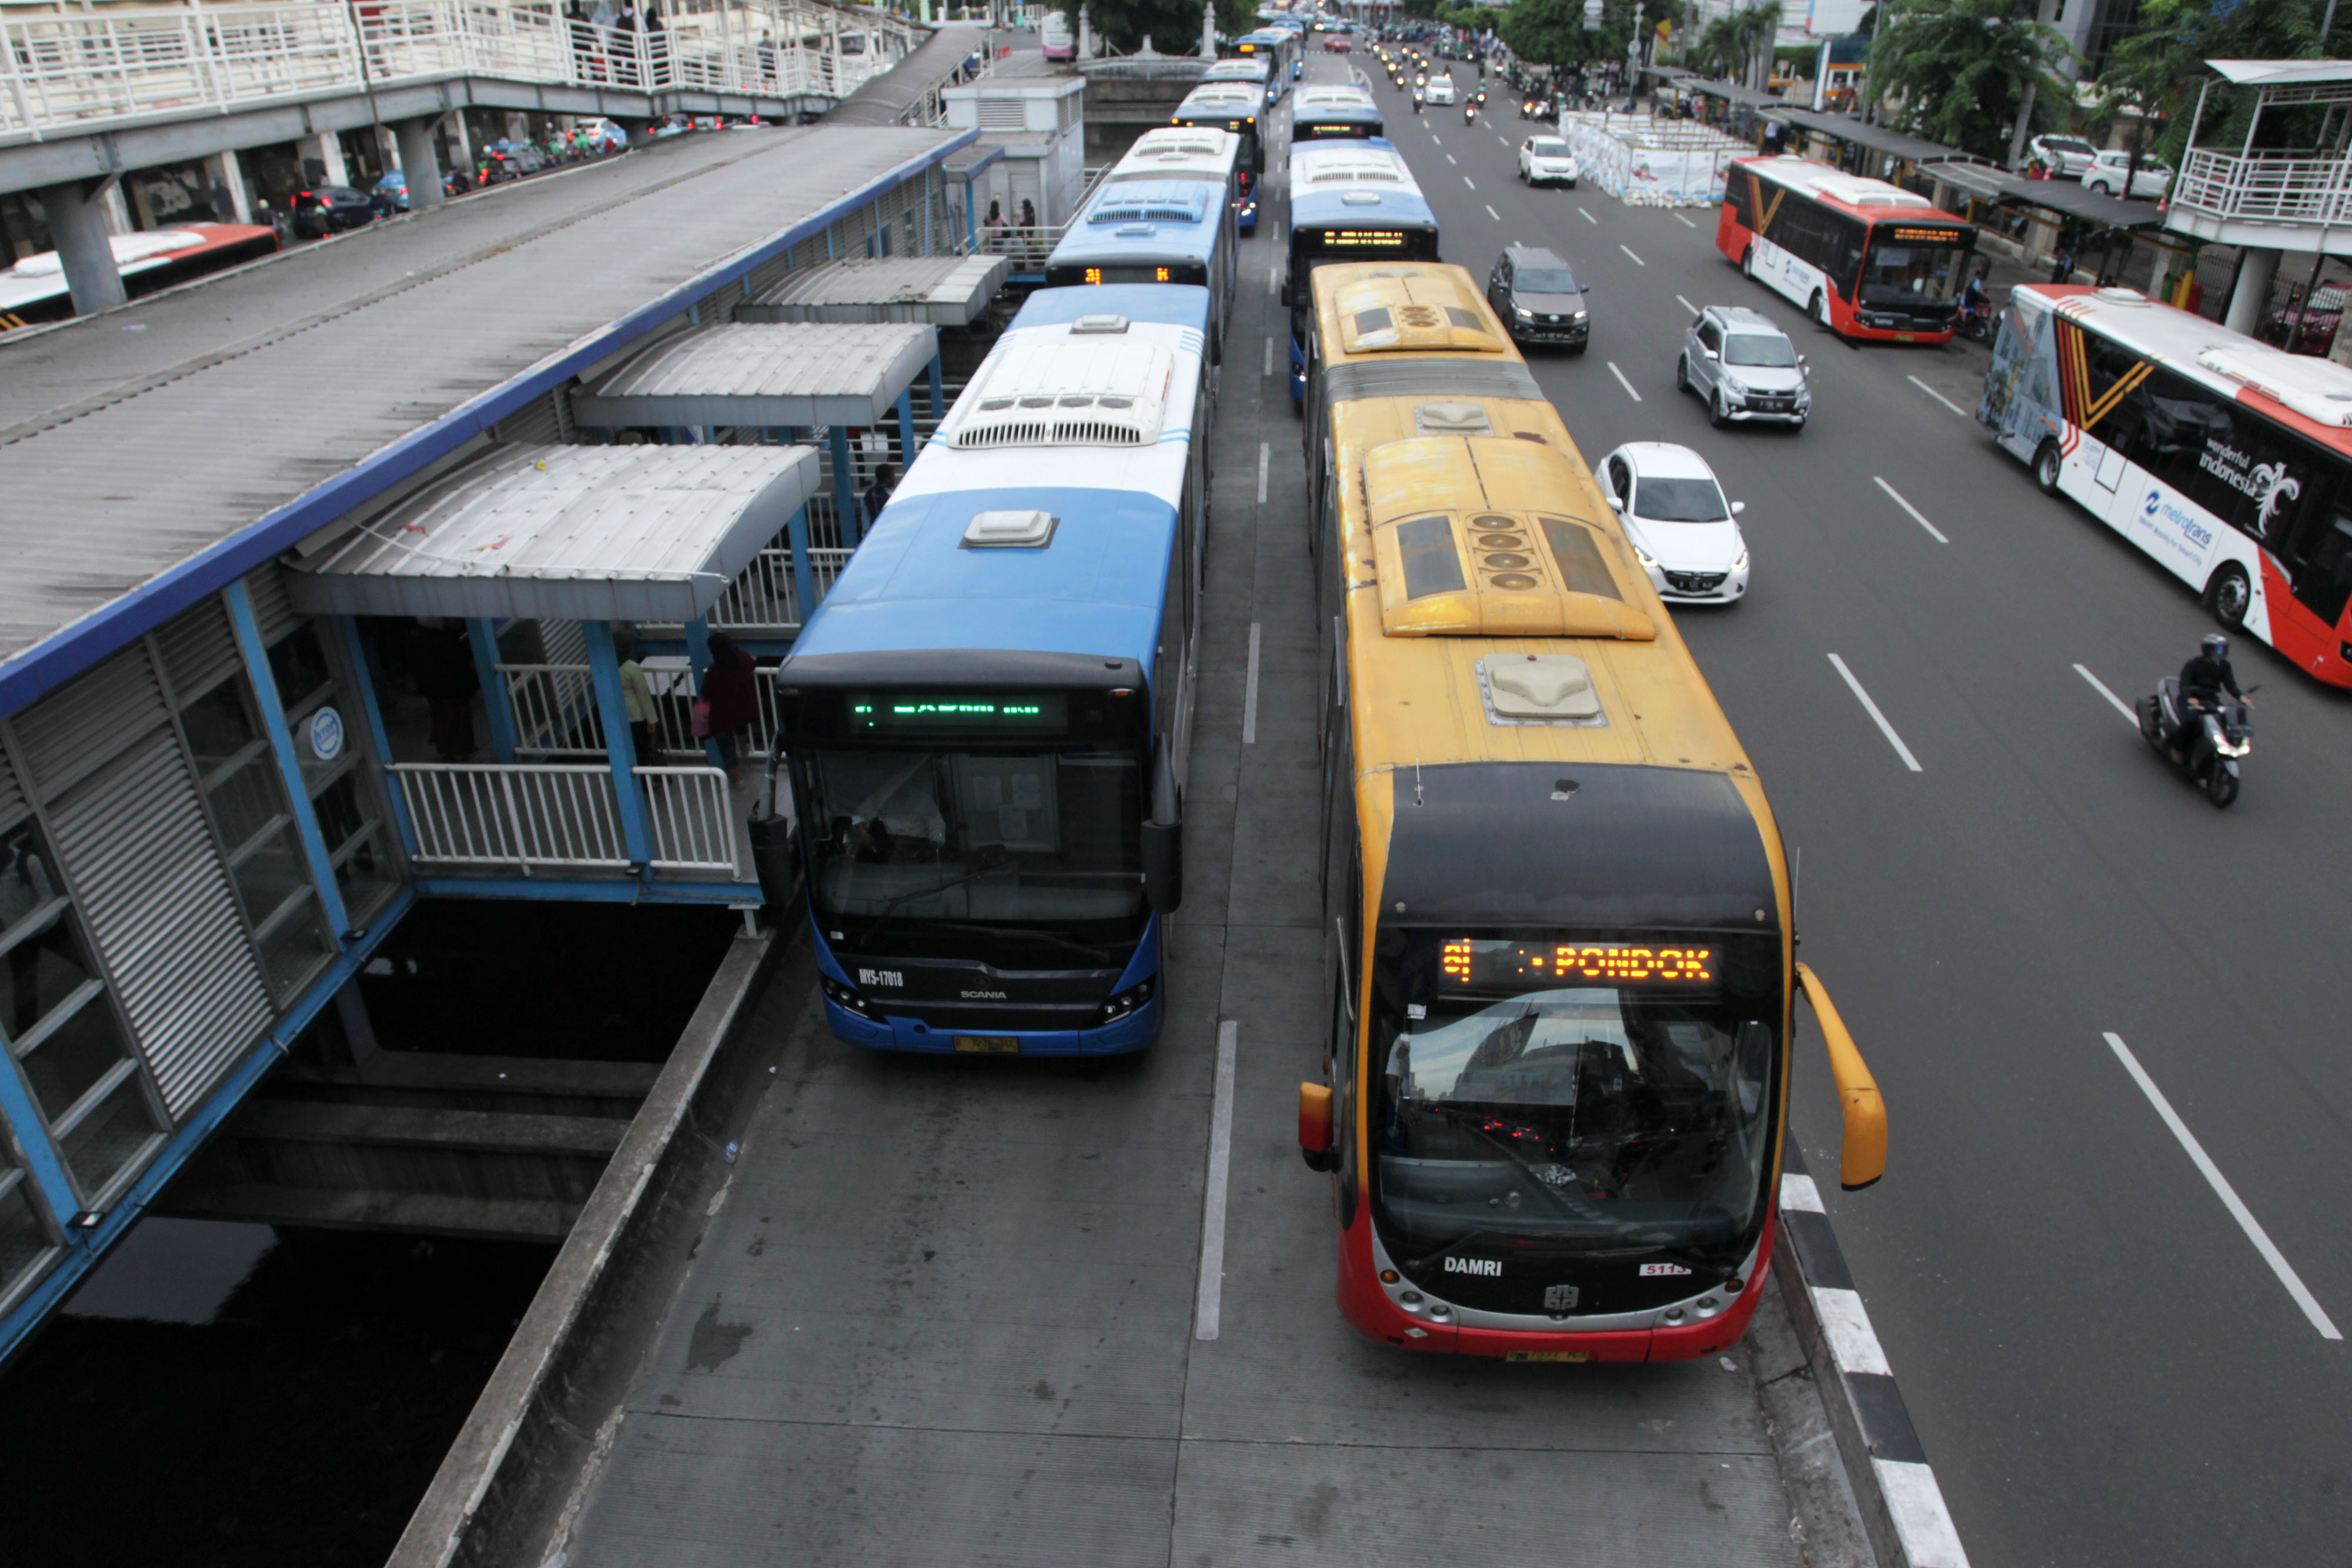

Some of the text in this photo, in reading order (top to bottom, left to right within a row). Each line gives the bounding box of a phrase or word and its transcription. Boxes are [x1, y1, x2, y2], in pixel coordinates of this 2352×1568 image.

[2207, 437, 2251, 469] wonderful
[2199, 452, 2257, 497] indonesia
[2160, 503, 2212, 550] metrotrans
[858, 968, 903, 987] MYS-17018
[1556, 948, 1709, 979] PONDOK
[961, 991, 1007, 999] SCANIA
[1444, 1256, 1502, 1276] DAMRI
